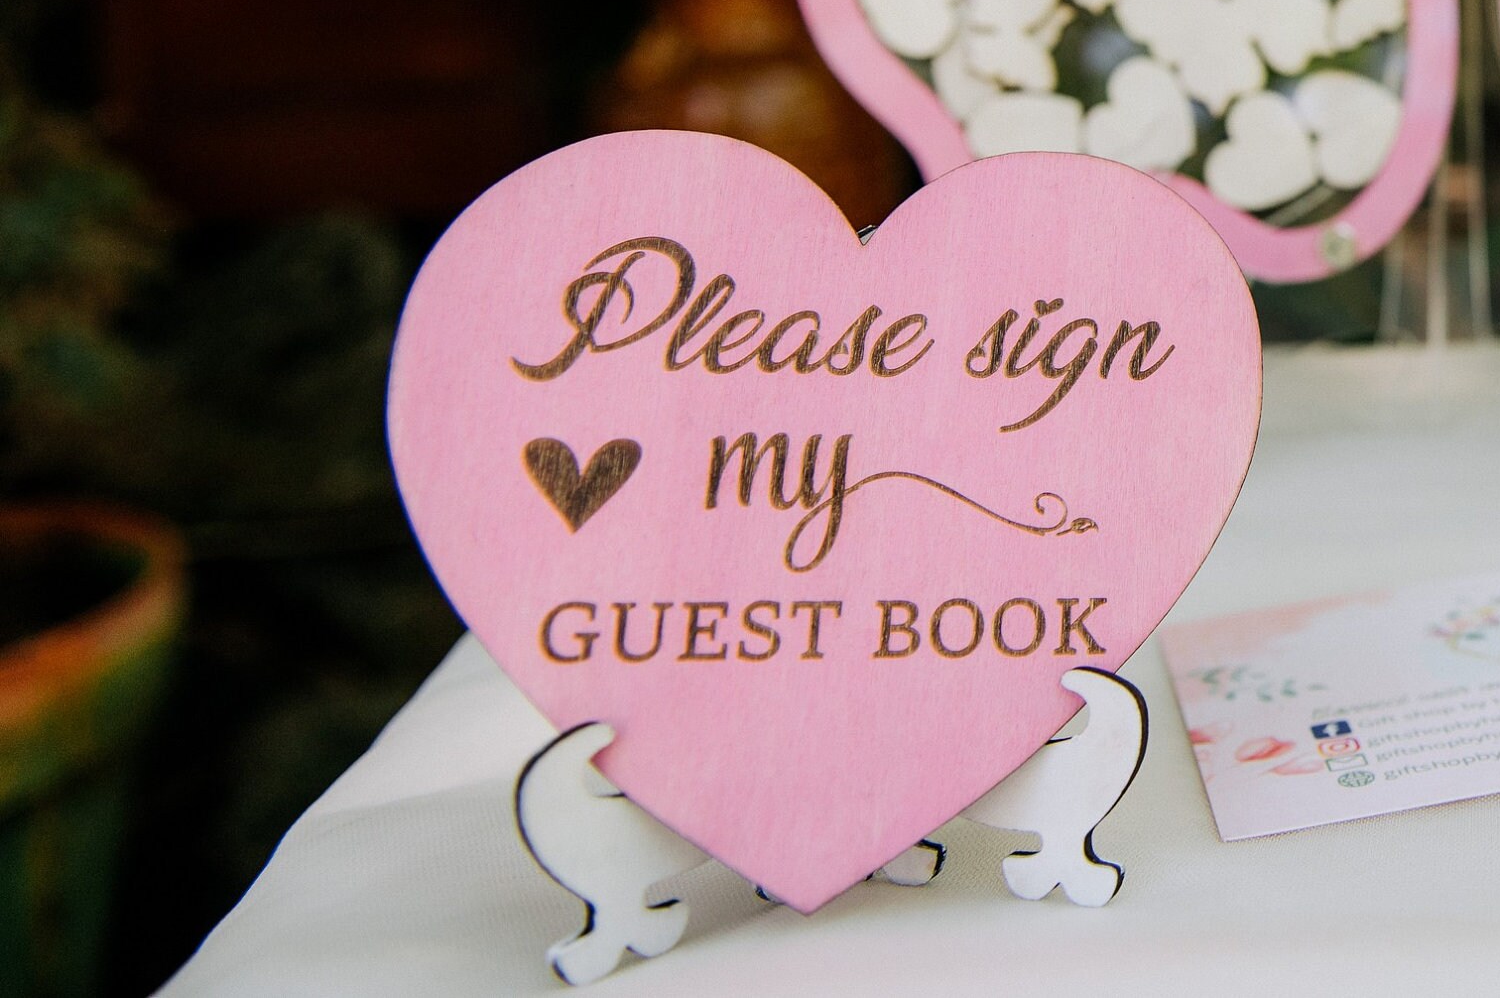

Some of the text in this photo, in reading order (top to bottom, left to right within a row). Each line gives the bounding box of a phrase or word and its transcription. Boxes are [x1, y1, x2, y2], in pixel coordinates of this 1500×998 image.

[510, 236, 1175, 433] Please sign
[539, 597, 1107, 664] GUEST BOOK
